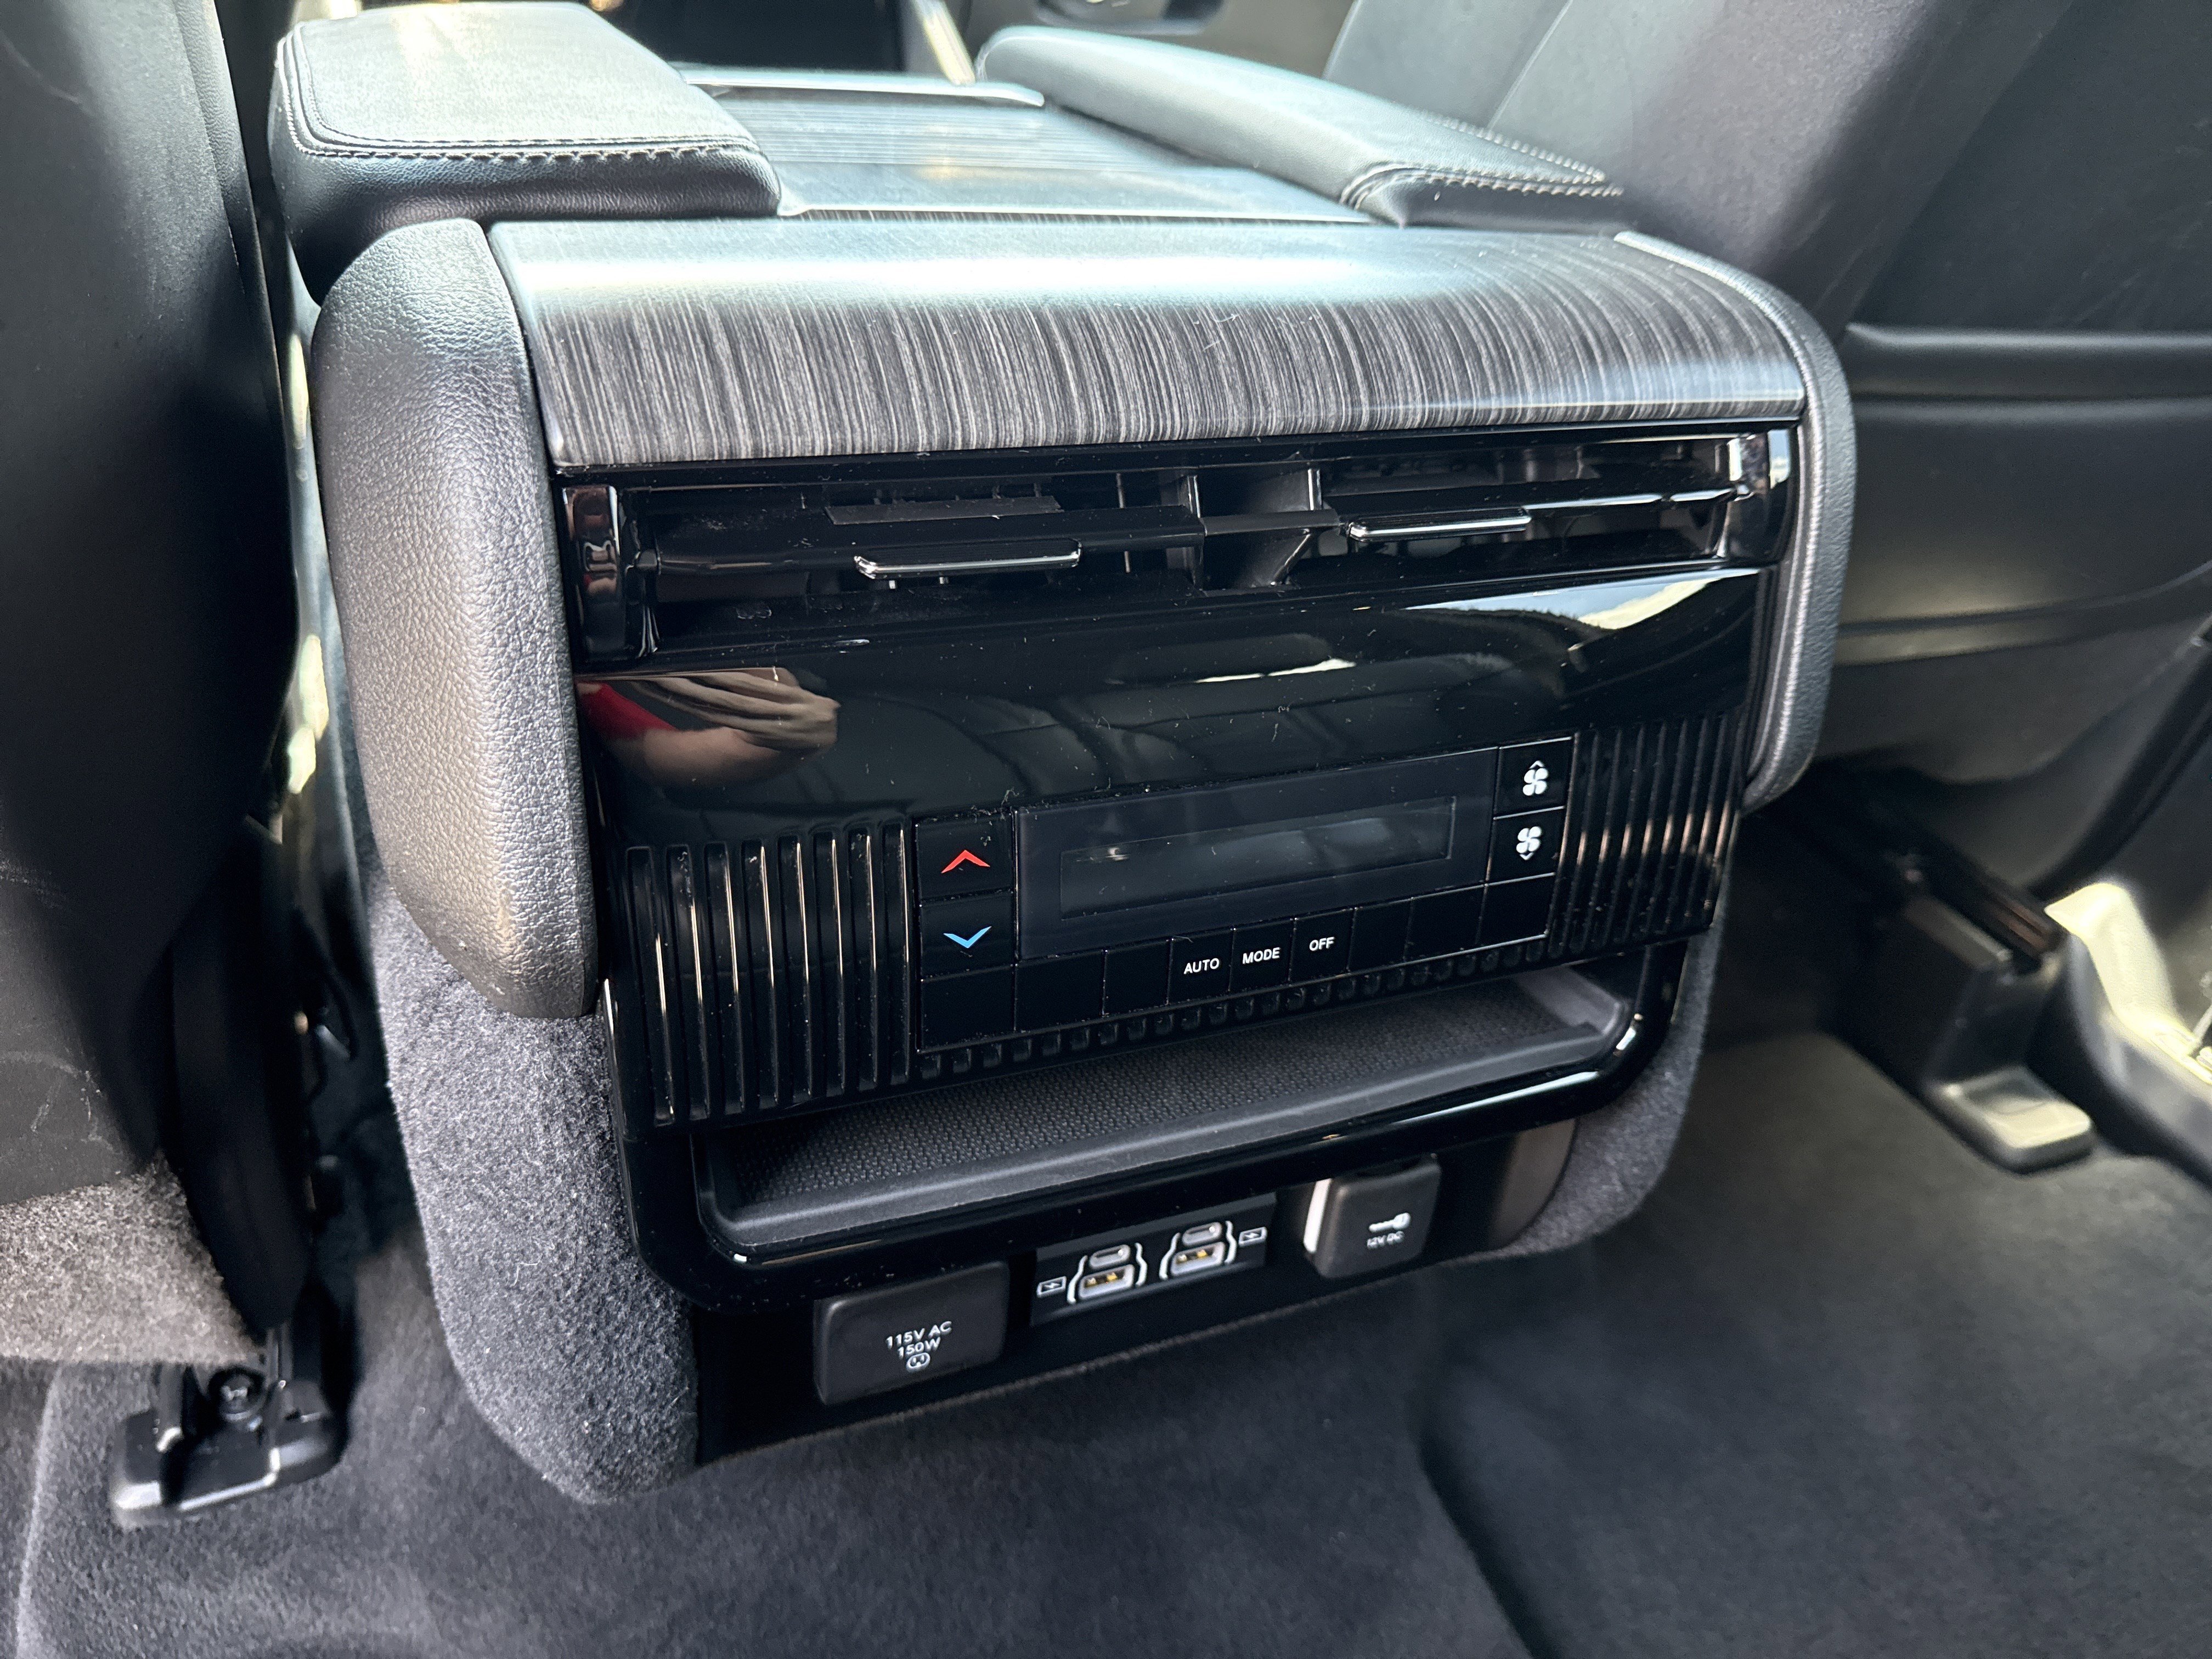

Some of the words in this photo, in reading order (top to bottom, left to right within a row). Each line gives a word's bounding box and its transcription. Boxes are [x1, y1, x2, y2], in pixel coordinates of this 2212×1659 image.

[1309, 936, 1335, 951] OFF
[1242, 947, 1281, 964] MODE
[1183, 958, 1220, 974] AUTO
[885, 1328, 926, 1349] 115V
[928, 1321, 952, 1338] AC
[897, 1336, 941, 1359] 150W
